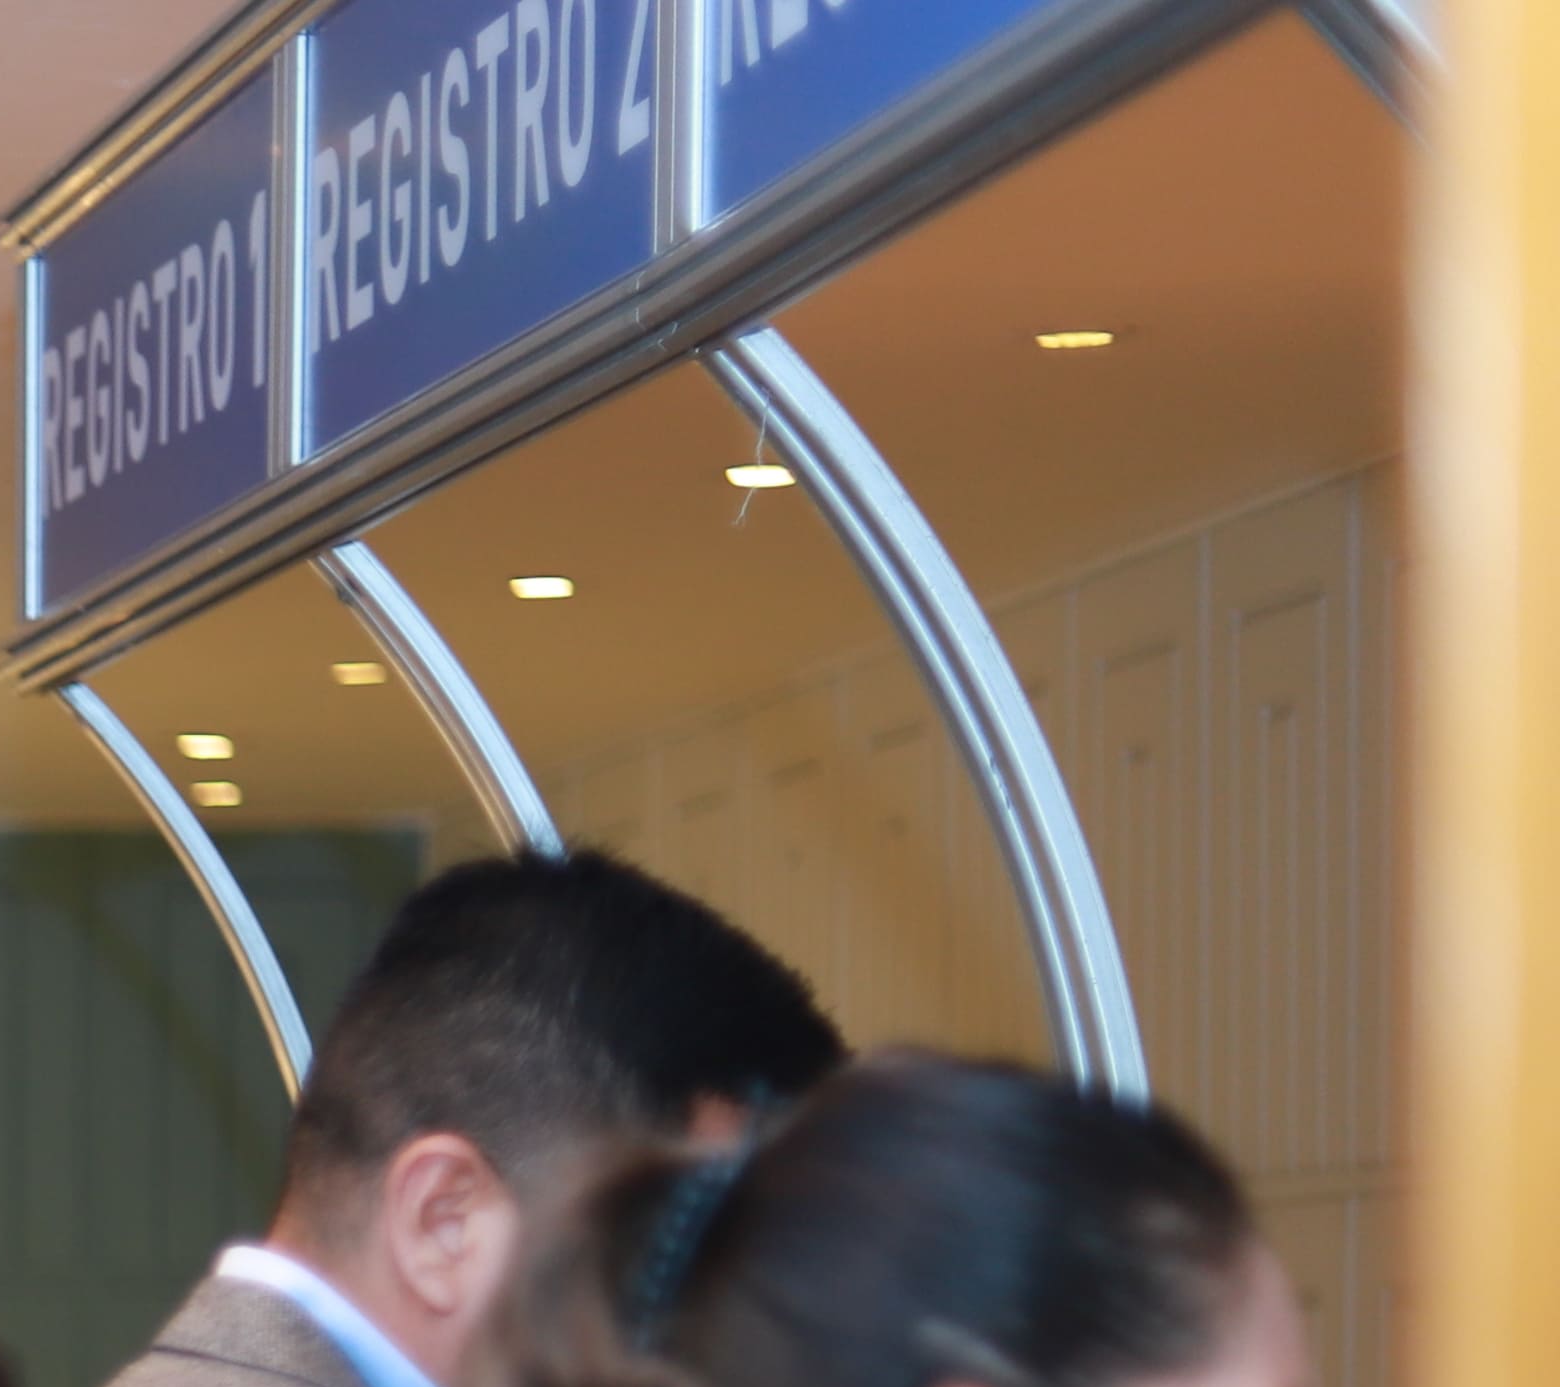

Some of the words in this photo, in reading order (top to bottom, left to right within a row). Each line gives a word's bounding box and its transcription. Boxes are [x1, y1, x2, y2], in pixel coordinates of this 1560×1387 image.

[312, 0, 596, 352] REGISTRO
[43, 219, 237, 518] REGISTRO
[249, 188, 267, 390] 1
